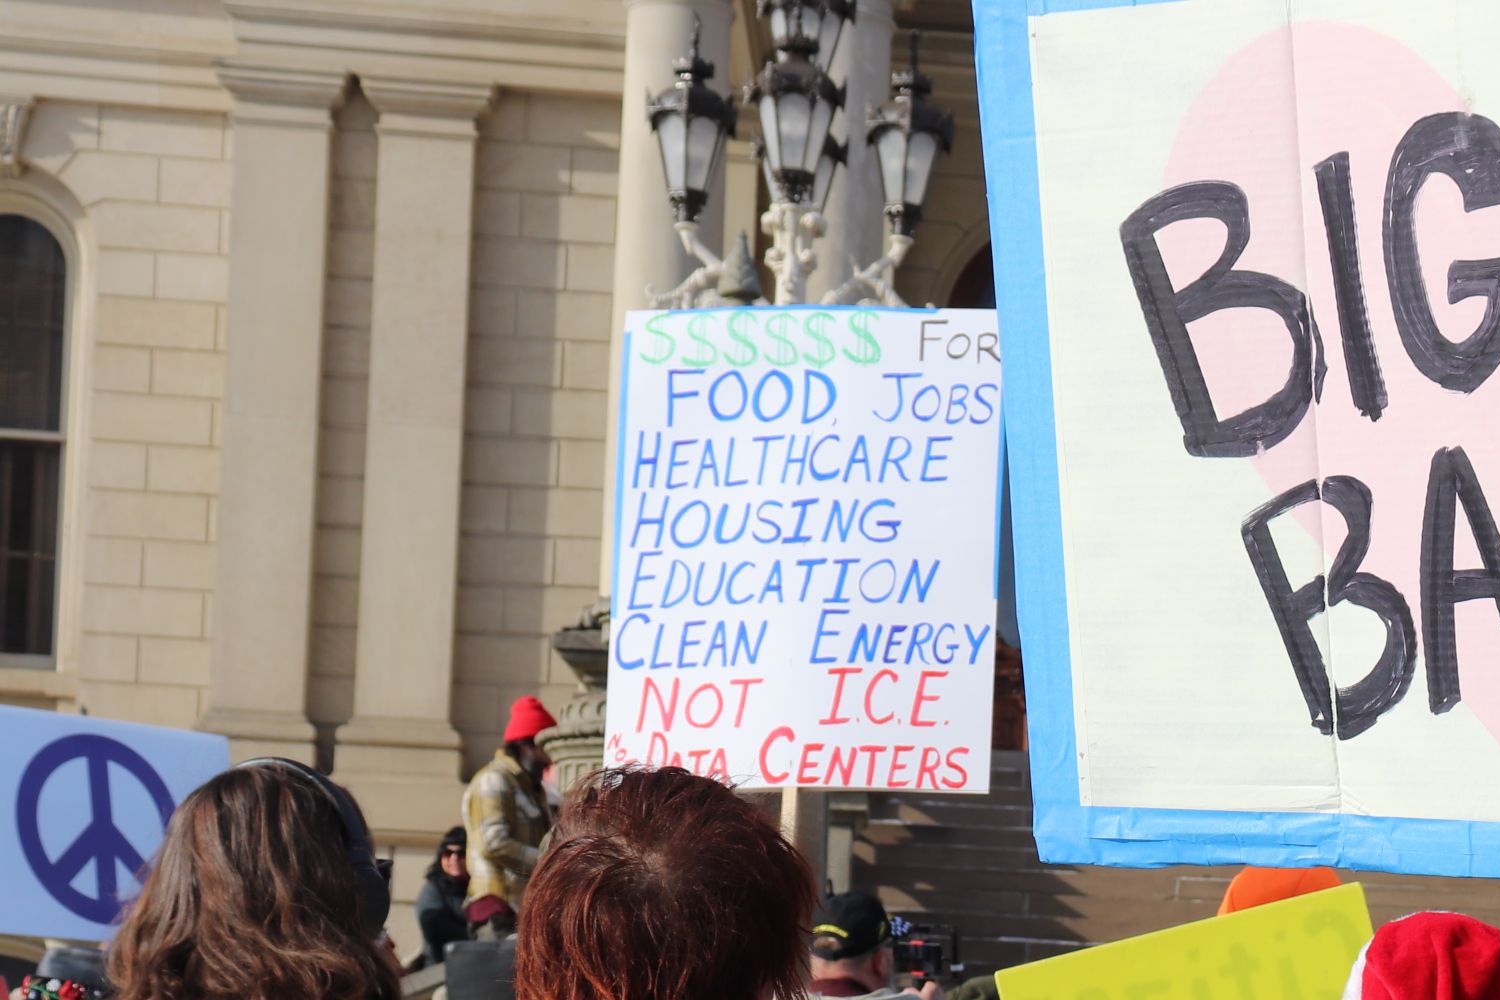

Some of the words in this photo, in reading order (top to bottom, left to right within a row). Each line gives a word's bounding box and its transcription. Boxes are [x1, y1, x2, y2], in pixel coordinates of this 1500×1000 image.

[920, 319, 1000, 364] FOR
[873, 372, 998, 425] JOBS
[633, 431, 953, 490] HEALTHCARE
[630, 492, 901, 549] HOUSING
[627, 550, 940, 610] EDUCATION
[615, 613, 768, 671] CLEAN
[809, 609, 991, 665] ENERGY
[635, 676, 764, 733] NOT
[819, 668, 950, 727] I.C.E.
[759, 726, 970, 790] CENTERS
